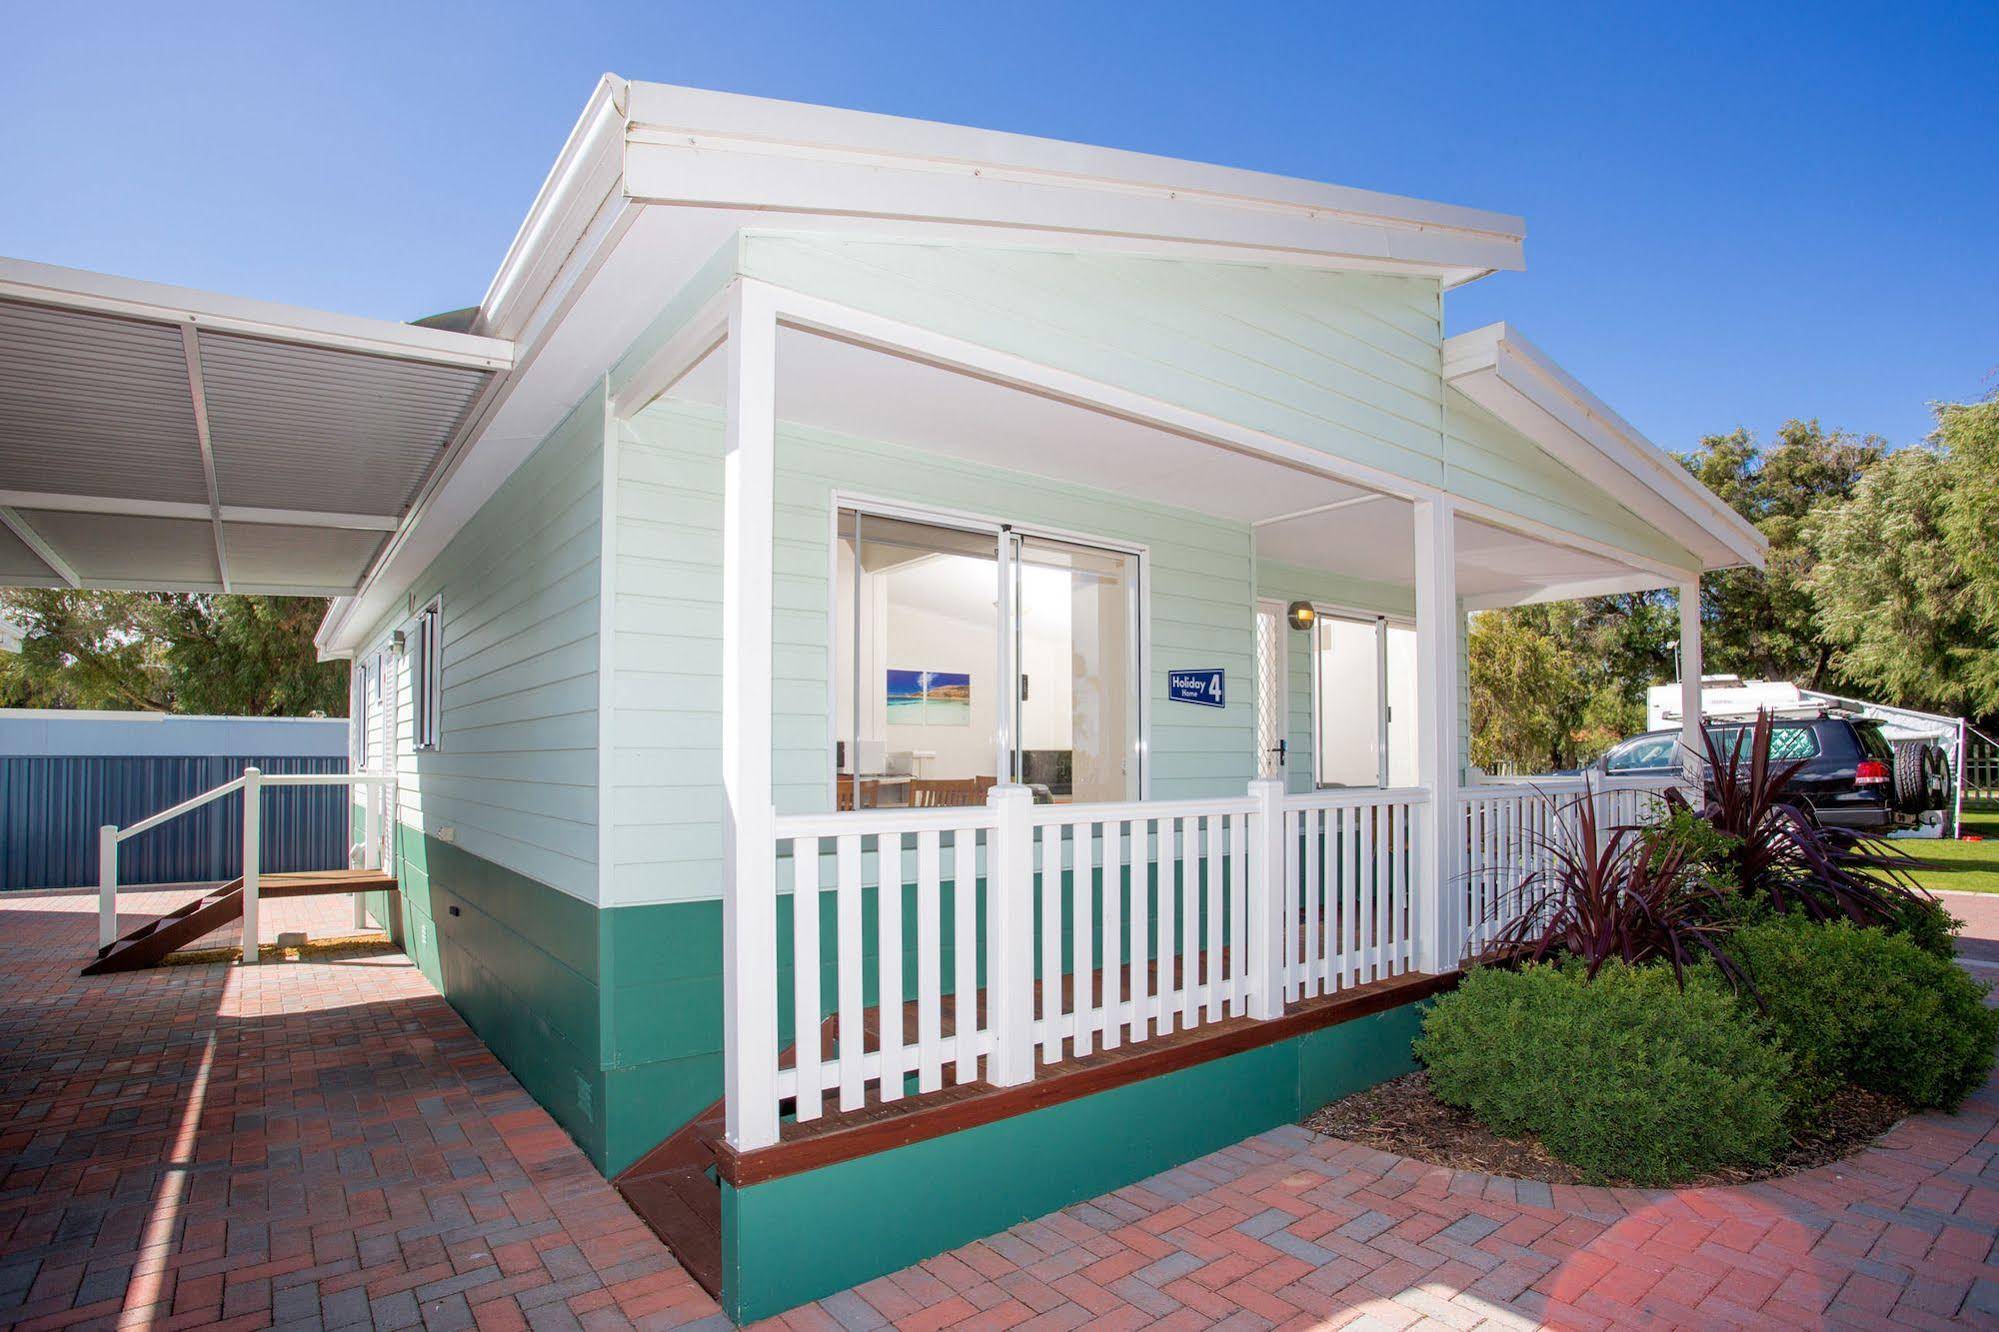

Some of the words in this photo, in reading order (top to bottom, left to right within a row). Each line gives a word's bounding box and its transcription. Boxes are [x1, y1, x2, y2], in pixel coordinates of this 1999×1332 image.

[1172, 676, 1206, 693] Holiday
[1209, 674, 1222, 702] 4
[1181, 689, 1198, 698] Home
